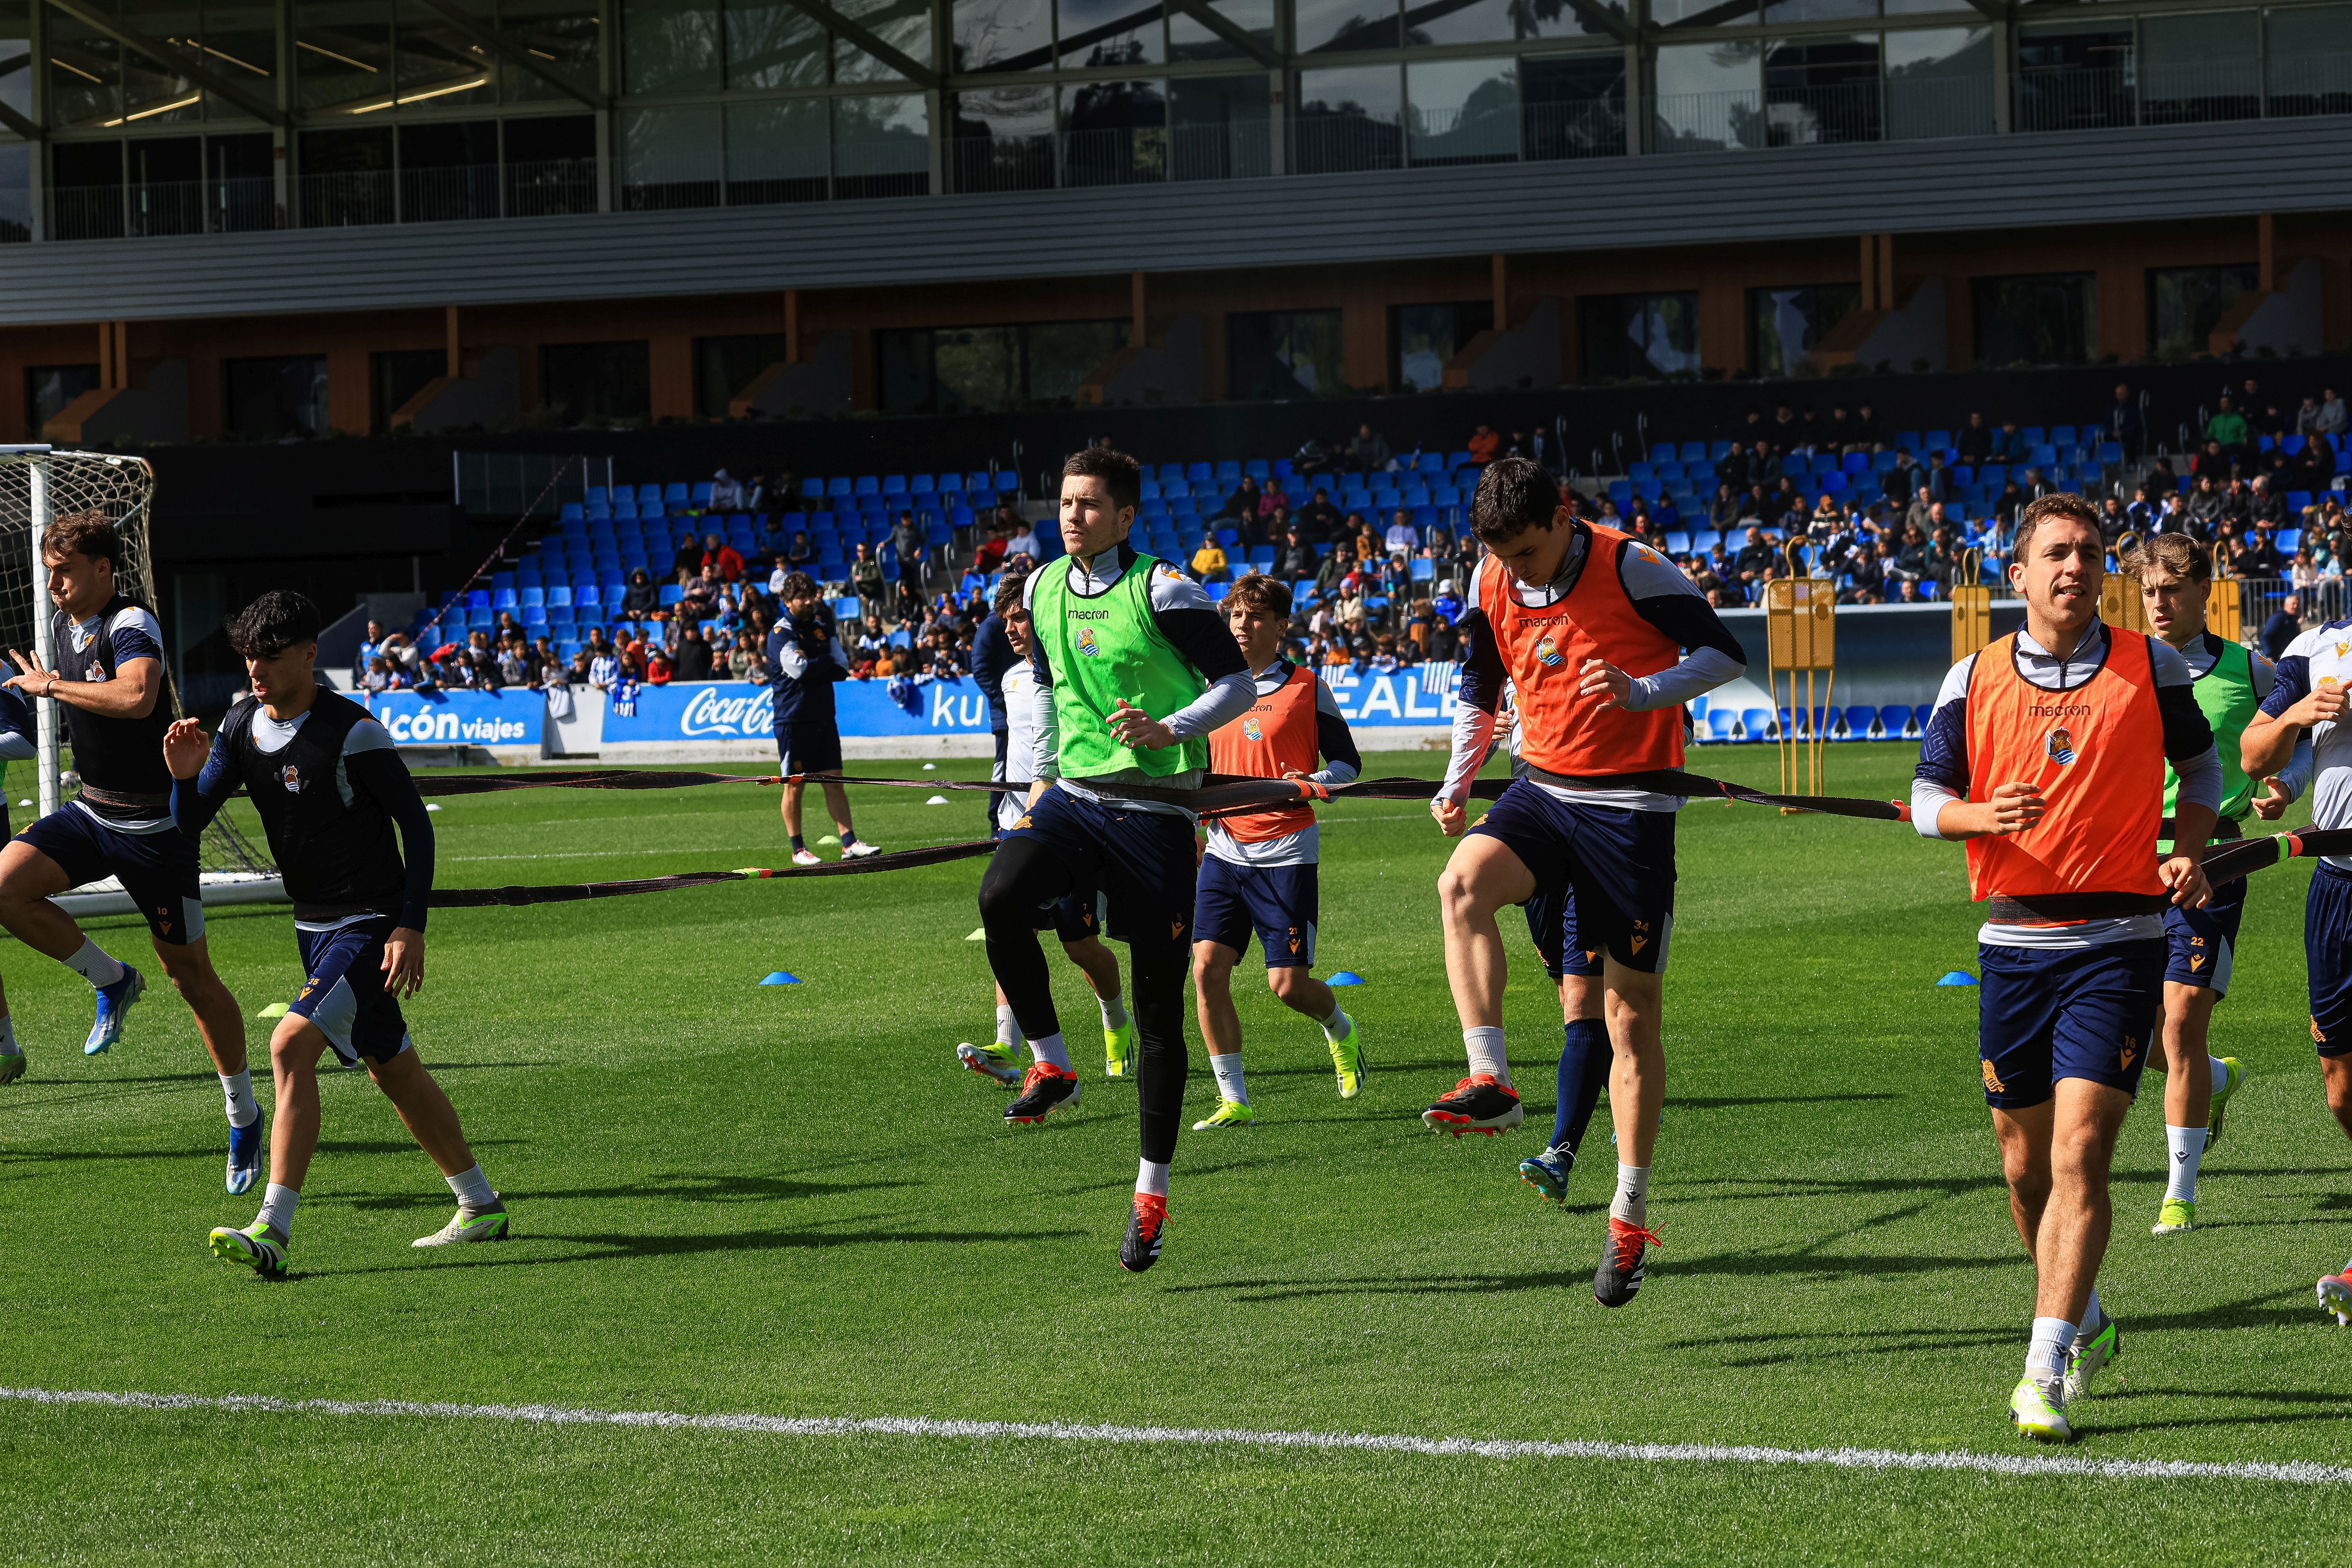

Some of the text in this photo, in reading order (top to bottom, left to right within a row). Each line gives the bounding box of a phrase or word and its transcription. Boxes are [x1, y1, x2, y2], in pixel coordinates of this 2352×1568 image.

[1068, 609, 1109, 620] macron
[1519, 613, 1568, 628] macron
[1328, 675, 1461, 719] EALE
[681, 687, 774, 736] Coca-Co
[931, 684, 984, 727] ku
[2029, 705, 2091, 717] macron
[380, 704, 526, 743] lcón viajes
[1634, 920, 1649, 932] 34
[2190, 936, 2204, 946] 22
[2125, 1035, 2136, 1047] 16
